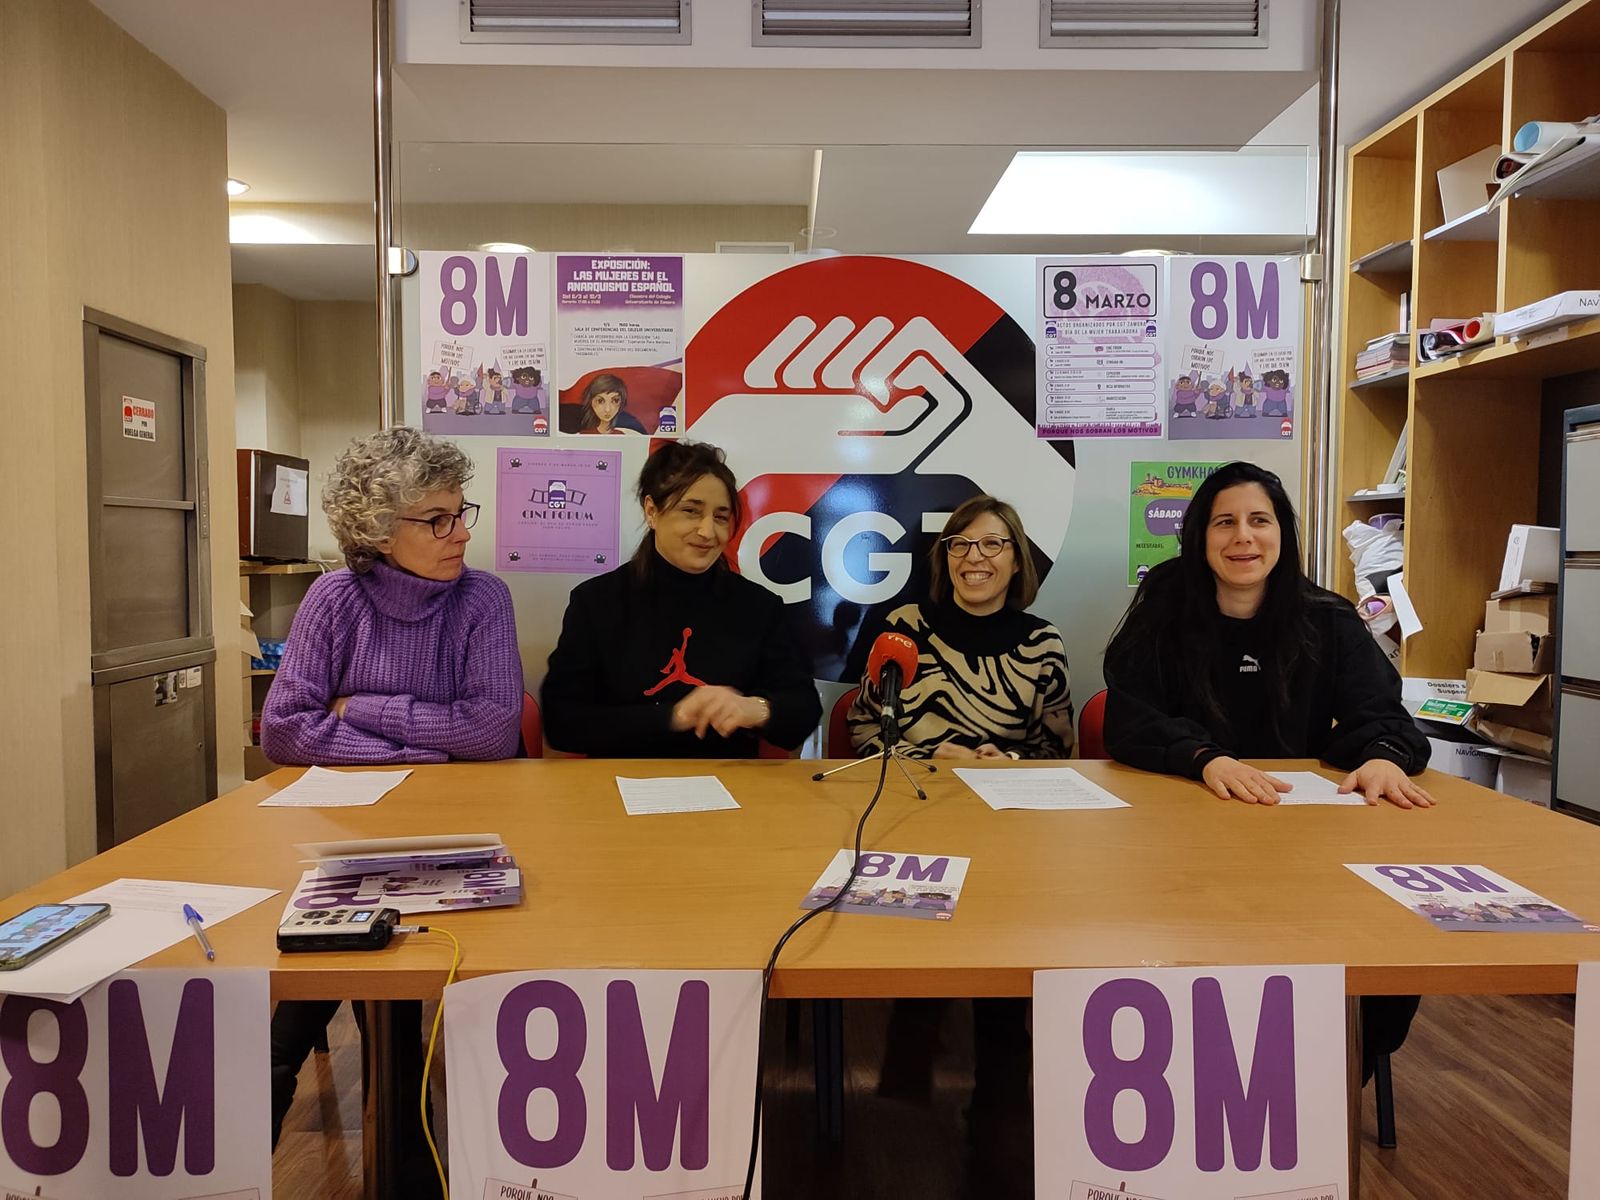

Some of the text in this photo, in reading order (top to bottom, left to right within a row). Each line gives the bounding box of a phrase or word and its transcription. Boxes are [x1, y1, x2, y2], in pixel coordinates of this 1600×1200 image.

[574, 271, 668, 281] LAS MUJERES EN EL
[592, 258, 650, 270] EXPOSICIÓN:
[440, 256, 528, 336] 8M
[567, 281, 675, 292] ANARQUISMO ESPAÑOL
[1054, 270, 1151, 310] 8 MARZO
[1190, 262, 1279, 340] 8M
[133, 406, 154, 418] CERRADO
[1148, 507, 1182, 518] SÁBADO
[888, 634, 912, 648] rne
[851, 854, 950, 882] 8M
[1374, 866, 1508, 893] 8M
[0, 978, 215, 1177] 8M
[496, 979, 710, 1172] 8M
[1082, 975, 1298, 1172] 8M
